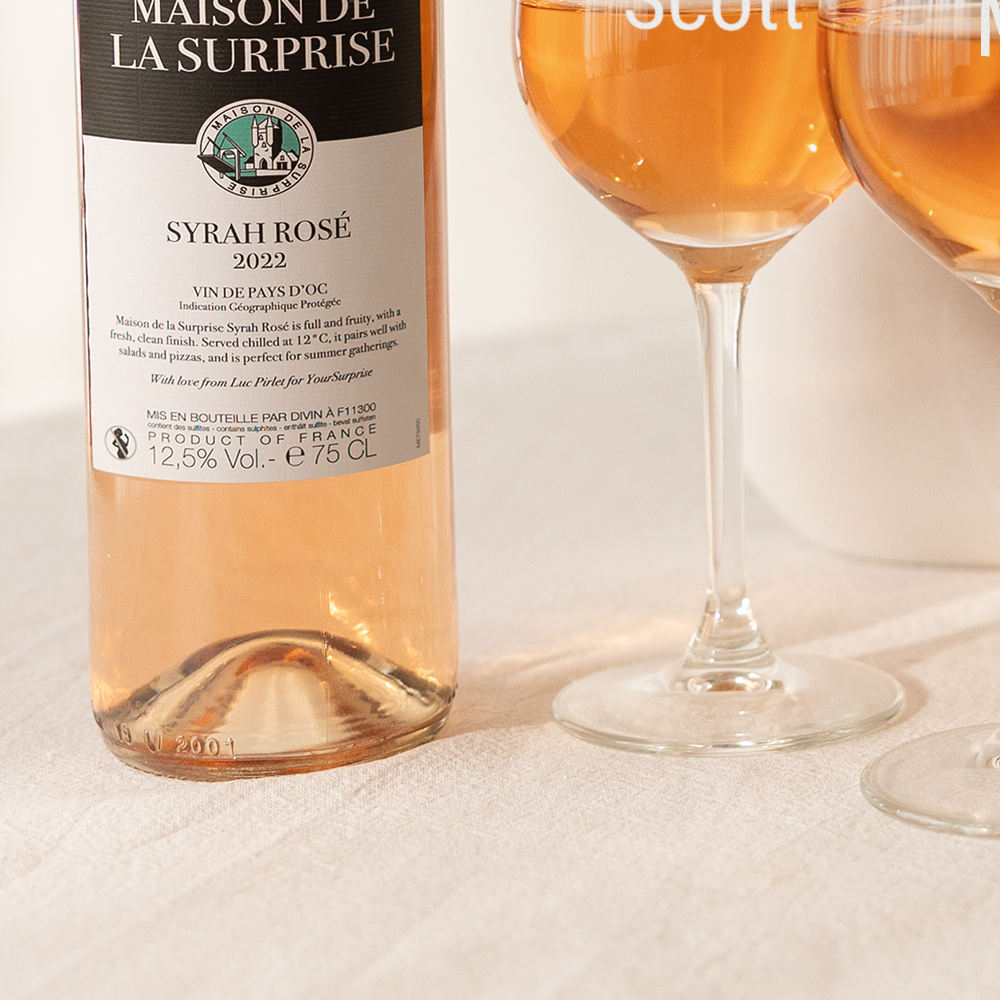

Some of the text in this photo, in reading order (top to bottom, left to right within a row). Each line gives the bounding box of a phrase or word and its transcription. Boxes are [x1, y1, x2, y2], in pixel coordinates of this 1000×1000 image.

[110, 28, 395, 73] LA SURPRISE
[211, 105, 311, 196] MAISON DE LA SURPRISE
[167, 211, 351, 244] SYRAH ROSÉ
[233, 252, 287, 269] 2022
[193, 286, 218, 298] VIN
[223, 287, 245, 298] DE
[248, 285, 285, 298] PAYS
[179, 298, 342, 313] Indication Géographique Protégée
[116, 315, 149, 329] Maison
[152, 319, 165, 329] de
[166, 320, 176, 331] la
[178, 321, 224, 335] Surprise
[227, 322, 258, 335] Syrah
[262, 321, 289, 332] Rosé
[292, 321, 301, 331] is
[304, 319, 321, 330] full
[324, 317, 343, 328] and
[345, 314, 375, 326] fruity,
[376, 308, 395, 321] with
[110, 329, 135, 342] fresh,
[137, 333, 163, 344] clean
[166, 336, 198, 347] finish.
[201, 337, 239, 348] Served
[242, 336, 280, 348] chilled
[282, 337, 293, 346] at
[334, 332, 341, 342] it
[344, 330, 368, 343] pairs
[370, 324, 388, 337] well
[389, 320, 407, 333] with
[119, 339, 399, 365] salads and pizzas, and is perfect for summer gatherings.
[151, 368, 373, 390] With love from Luc Pirlet for YourSurprise
[146, 402, 376, 423] MIS EN BOUTEILLE PAR DIVIN À F11300
[148, 423, 377, 446] PRODUCT OF FRANCE
[149, 445, 217, 470] 12,5%
[312, 442, 340, 465] 75
[348, 438, 377, 460] CL
[175, 734, 236, 757] 2001
